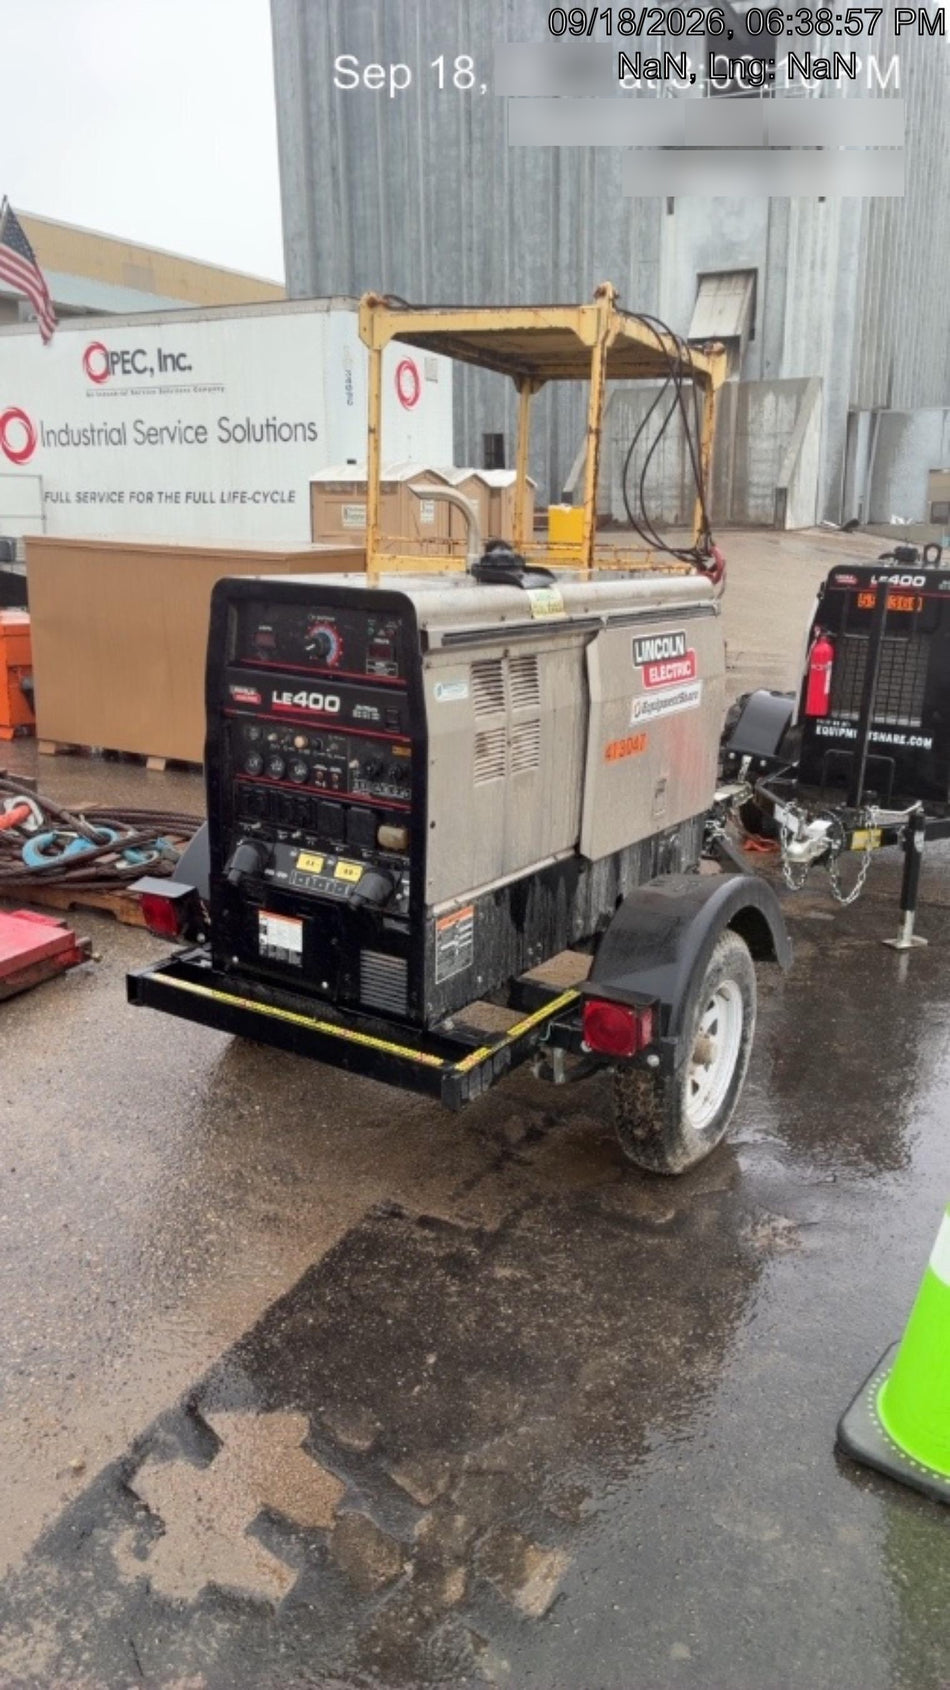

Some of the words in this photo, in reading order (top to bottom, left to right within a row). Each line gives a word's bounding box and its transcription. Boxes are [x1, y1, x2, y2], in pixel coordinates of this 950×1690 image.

[157, 347, 193, 373] Inc.
[40, 420, 127, 448] Industrial
[133, 418, 208, 446] Service
[217, 416, 318, 444] Solutions
[44, 491, 72, 504] FULL
[75, 491, 125, 504] SERVICE
[129, 491, 154, 504] FOR
[157, 491, 181, 504] THE
[185, 491, 216, 504] FULL
[220, 490, 296, 504] LIFE-CYCLE
[634, 634, 686, 664] LINCOLN
[647, 660, 692, 685] ELECTRIC
[271, 690, 341, 713] LE400
